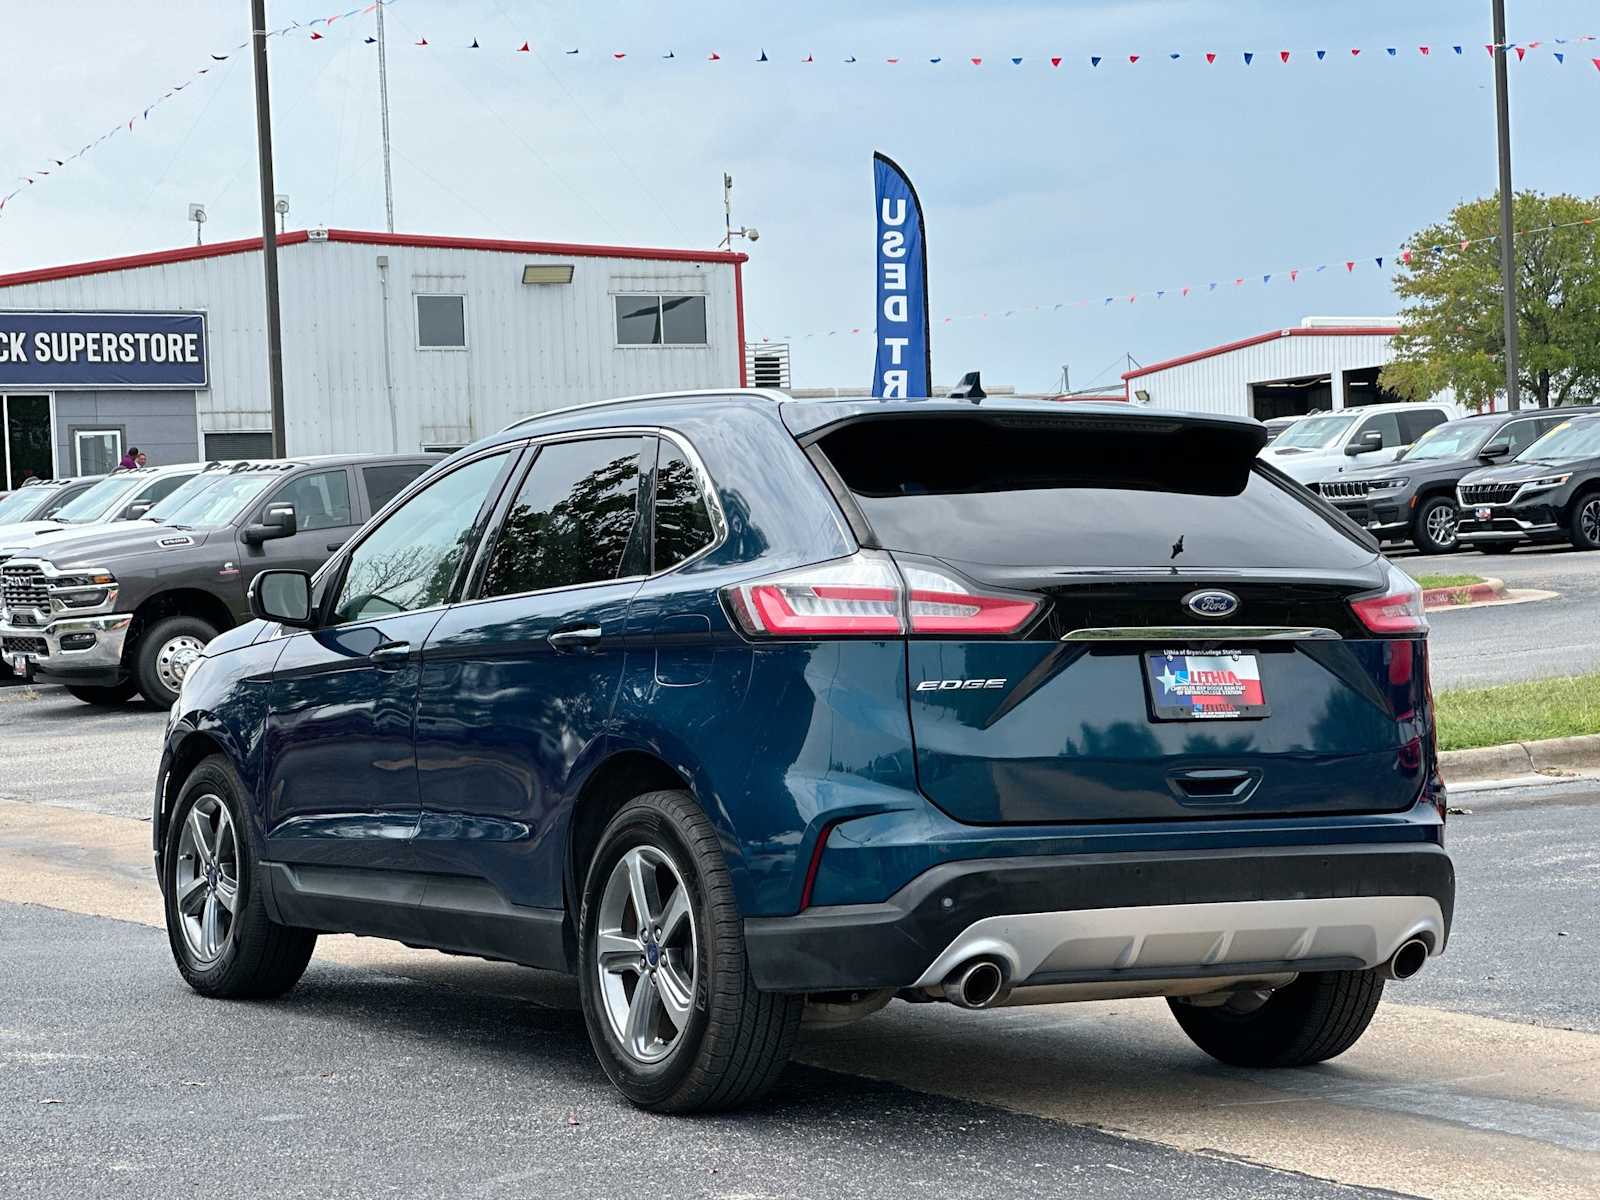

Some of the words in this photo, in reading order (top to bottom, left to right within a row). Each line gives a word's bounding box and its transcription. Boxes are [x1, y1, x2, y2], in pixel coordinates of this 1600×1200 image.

[34, 332, 200, 363] SUPERSTORE
[1201, 596, 1228, 610] Ford
[916, 679, 1007, 690] EDGE
[1189, 671, 1242, 685] LITHIA
